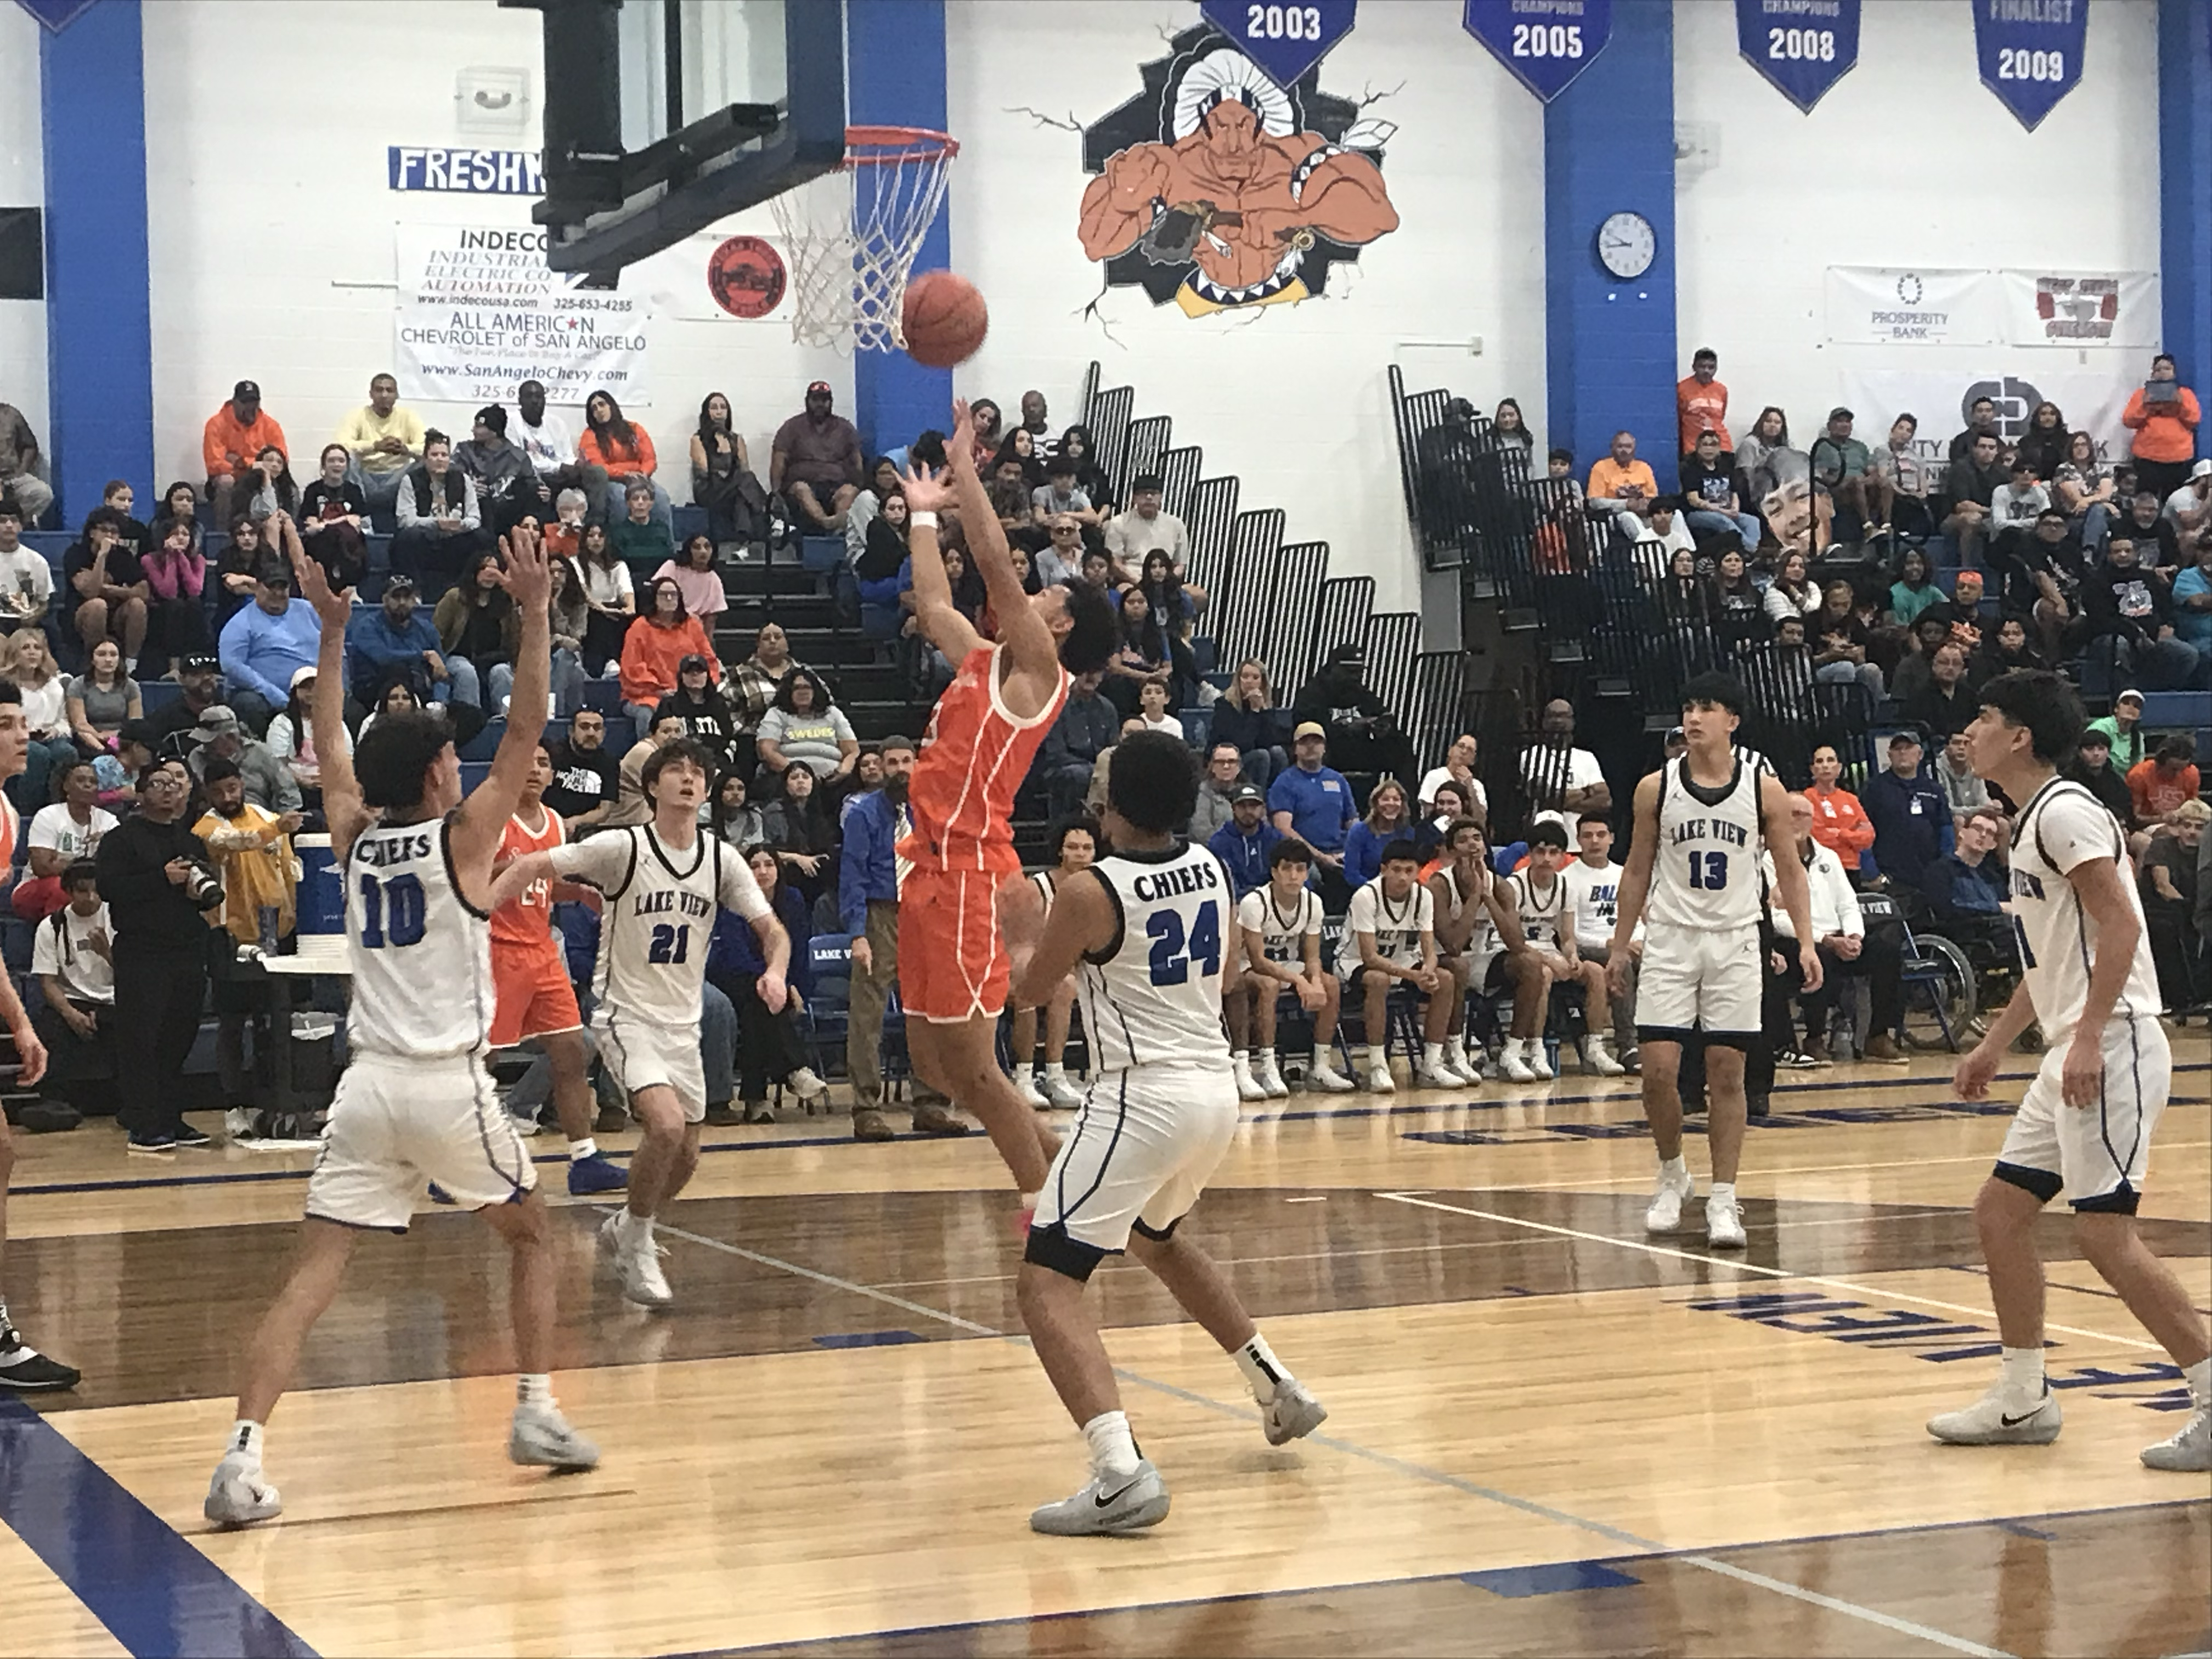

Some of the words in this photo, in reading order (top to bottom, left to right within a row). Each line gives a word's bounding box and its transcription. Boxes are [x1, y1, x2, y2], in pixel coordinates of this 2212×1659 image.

[1248, 4, 1321, 41] 2003
[1513, 24, 1583, 58] 2005
[1769, 27, 1835, 61] 2008
[1999, 48, 2064, 82] 2009
[425, 265, 516, 280] ELECTRIC
[421, 279, 551, 295] AUTOMATION
[417, 295, 538, 308] www.indecousa.com
[450, 312, 488, 330] ALL
[1871, 312, 1948, 325] PROSPERITY
[1893, 326, 1928, 338] BANK
[401, 328, 505, 348] CHEVROLET
[512, 332, 529, 347] of
[535, 334, 569, 348] SAN
[576, 334, 646, 351] ANGELO
[422, 363, 628, 382] www.SanAngeloChevy.com
[1670, 819, 1706, 847] LAKE
[1711, 819, 1748, 848] VIEW
[1134, 862, 1217, 902] CHIEFS
[1688, 850, 1728, 890] 13
[361, 872, 427, 949] 10
[634, 890, 674, 917] LAKE
[680, 891, 712, 918] VIEW
[648, 924, 691, 964] 21
[813, 949, 842, 960] LAKE
[1146, 899, 1221, 987] 24
